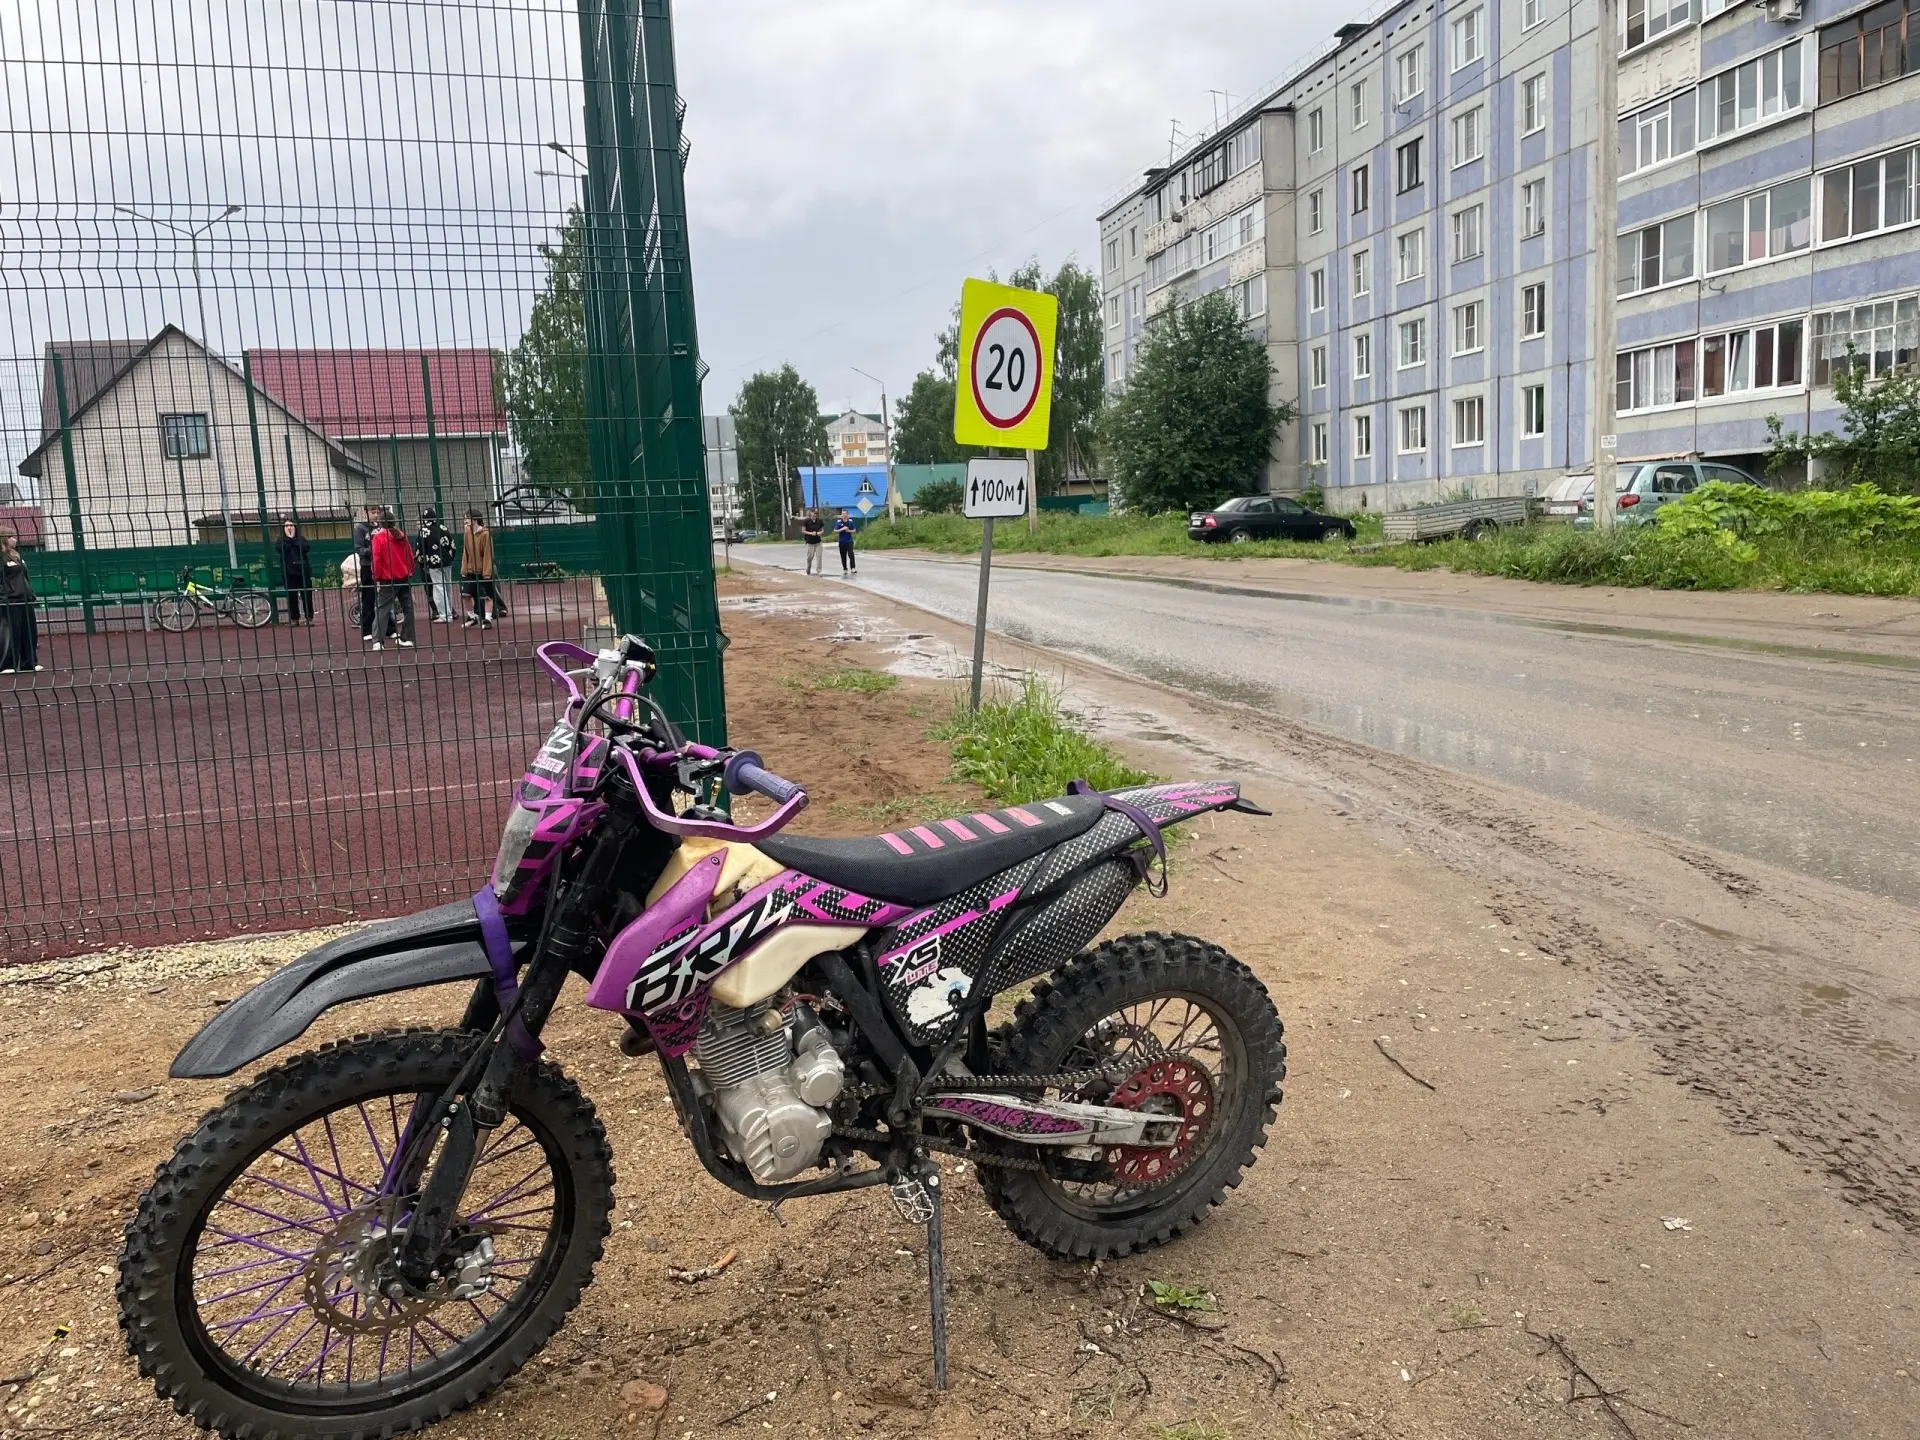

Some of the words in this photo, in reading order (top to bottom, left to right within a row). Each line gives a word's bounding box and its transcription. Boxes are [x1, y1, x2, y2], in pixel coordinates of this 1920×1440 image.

[985, 343, 1025, 392] 20
[905, 960, 938, 986] LITE
[935, 1097, 1025, 1128] RACING
